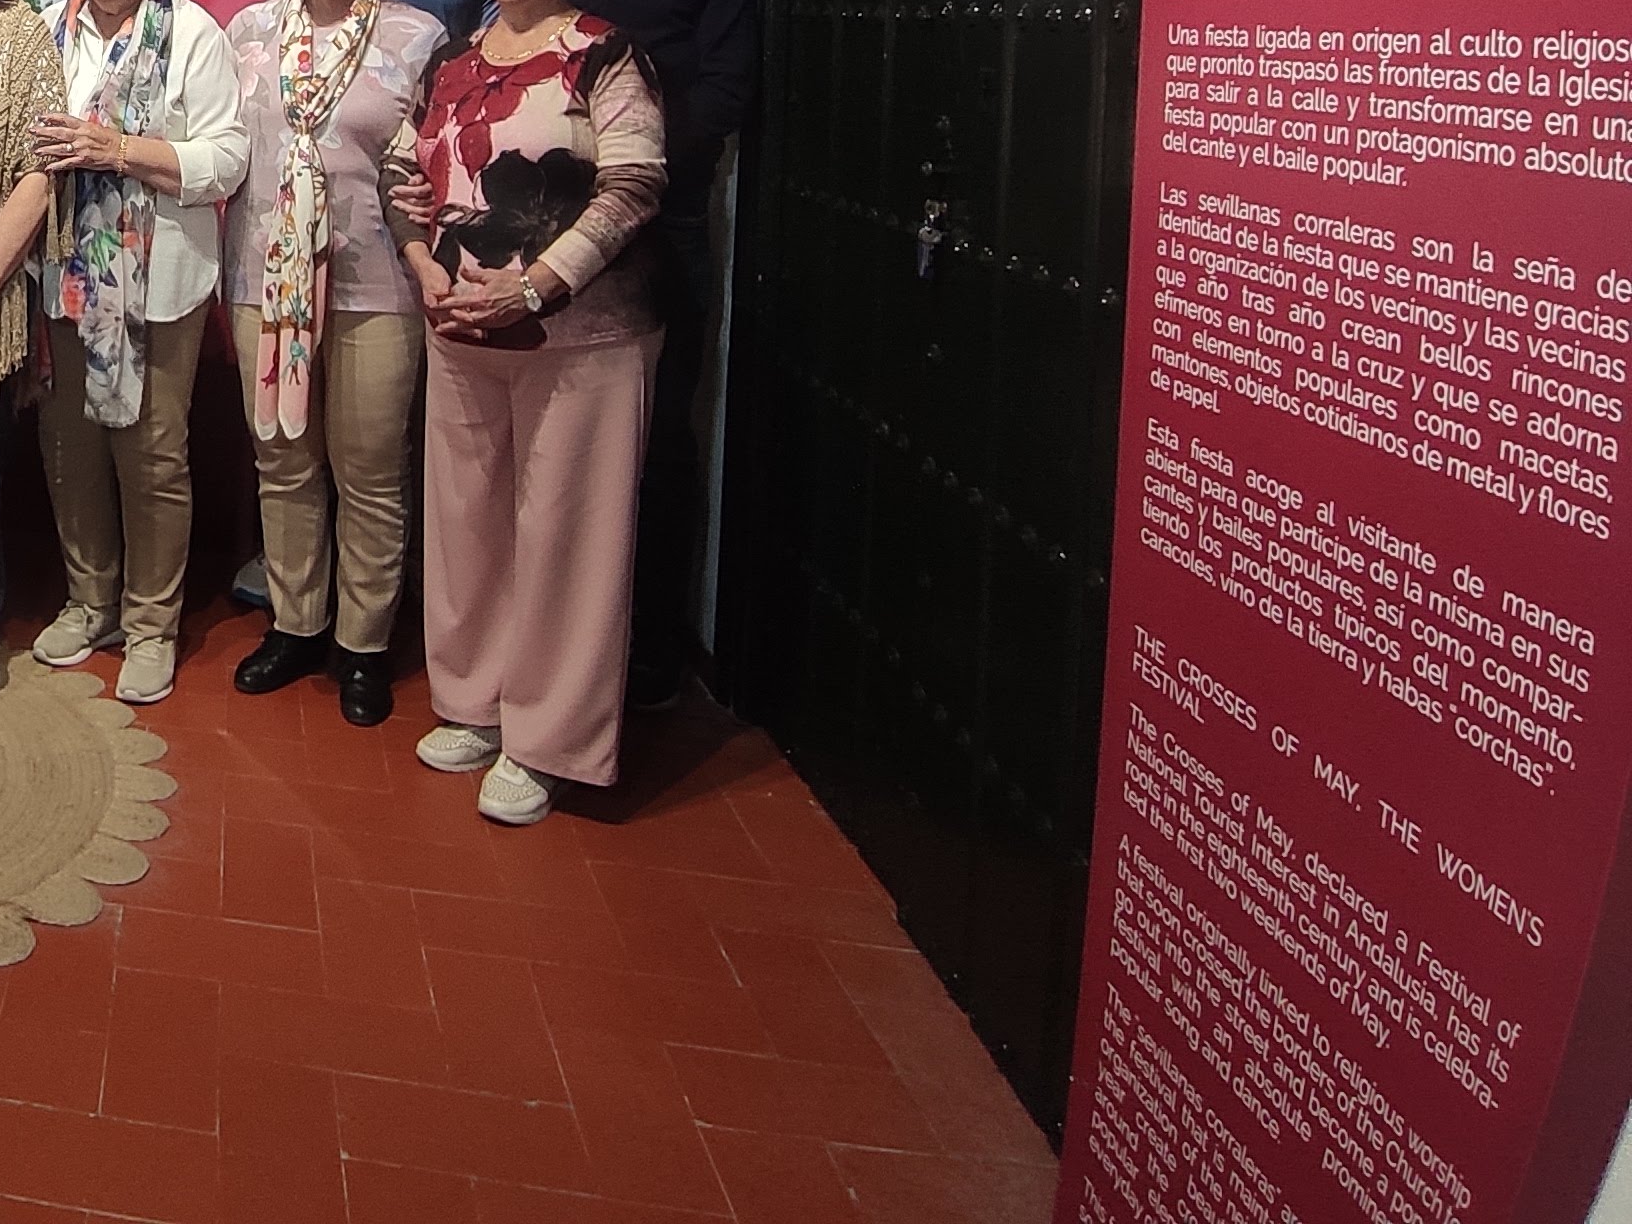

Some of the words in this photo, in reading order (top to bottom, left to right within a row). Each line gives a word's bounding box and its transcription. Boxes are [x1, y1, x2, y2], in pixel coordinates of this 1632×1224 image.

[1165, 81, 1199, 102] para
[1207, 80, 1241, 103] salir
[1247, 87, 1258, 106] a
[1267, 83, 1283, 108] la
[1292, 87, 1338, 113] calle
[1347, 95, 1360, 122] y
[1369, 92, 1532, 131] transformarse
[1545, 113, 1578, 136] en
[1169, 24, 1198, 46] Una
[1205, 24, 1248, 47] fiesta
[1256, 25, 1311, 55] ligada
[1319, 32, 1344, 51] en
[1352, 27, 1420, 62] origen
[1430, 28, 1452, 55] al
[1460, 29, 1522, 58] culto
[1533, 32, 1632, 69] religios
[1159, 207, 1231, 244] identidad
[1236, 226, 1259, 251] de
[1263, 231, 1278, 256] la
[1283, 235, 1333, 270] fiesta
[1339, 254, 1380, 281] que
[1384, 265, 1411, 288] se
[1416, 272, 1528, 317] mantiene
[1535, 300, 1629, 343] gracias
[1148, 418, 1178, 450] Esta
[1191, 437, 1233, 477] fiesta
[1246, 469, 1303, 510] acoge
[1316, 501, 1335, 527] al
[1348, 516, 1436, 574] visitante
[1453, 565, 1484, 599] de
[1502, 591, 1594, 655] manera
[1132, 655, 1204, 724] FESTIVAL
[1135, 625, 1166, 665] THE
[1178, 659, 1256, 731] CROSSES
[1272, 726, 1299, 757] OF
[1378, 799, 1421, 854] THE
[1119, 834, 1130, 857] A
[1134, 845, 1183, 911] festival
[1187, 903, 1256, 984] originally
[1259, 968, 1310, 1036] linked
[1313, 1024, 1330, 1056] to
[1334, 1051, 1404, 1136] religious
[1409, 1128, 1471, 1208] worship
